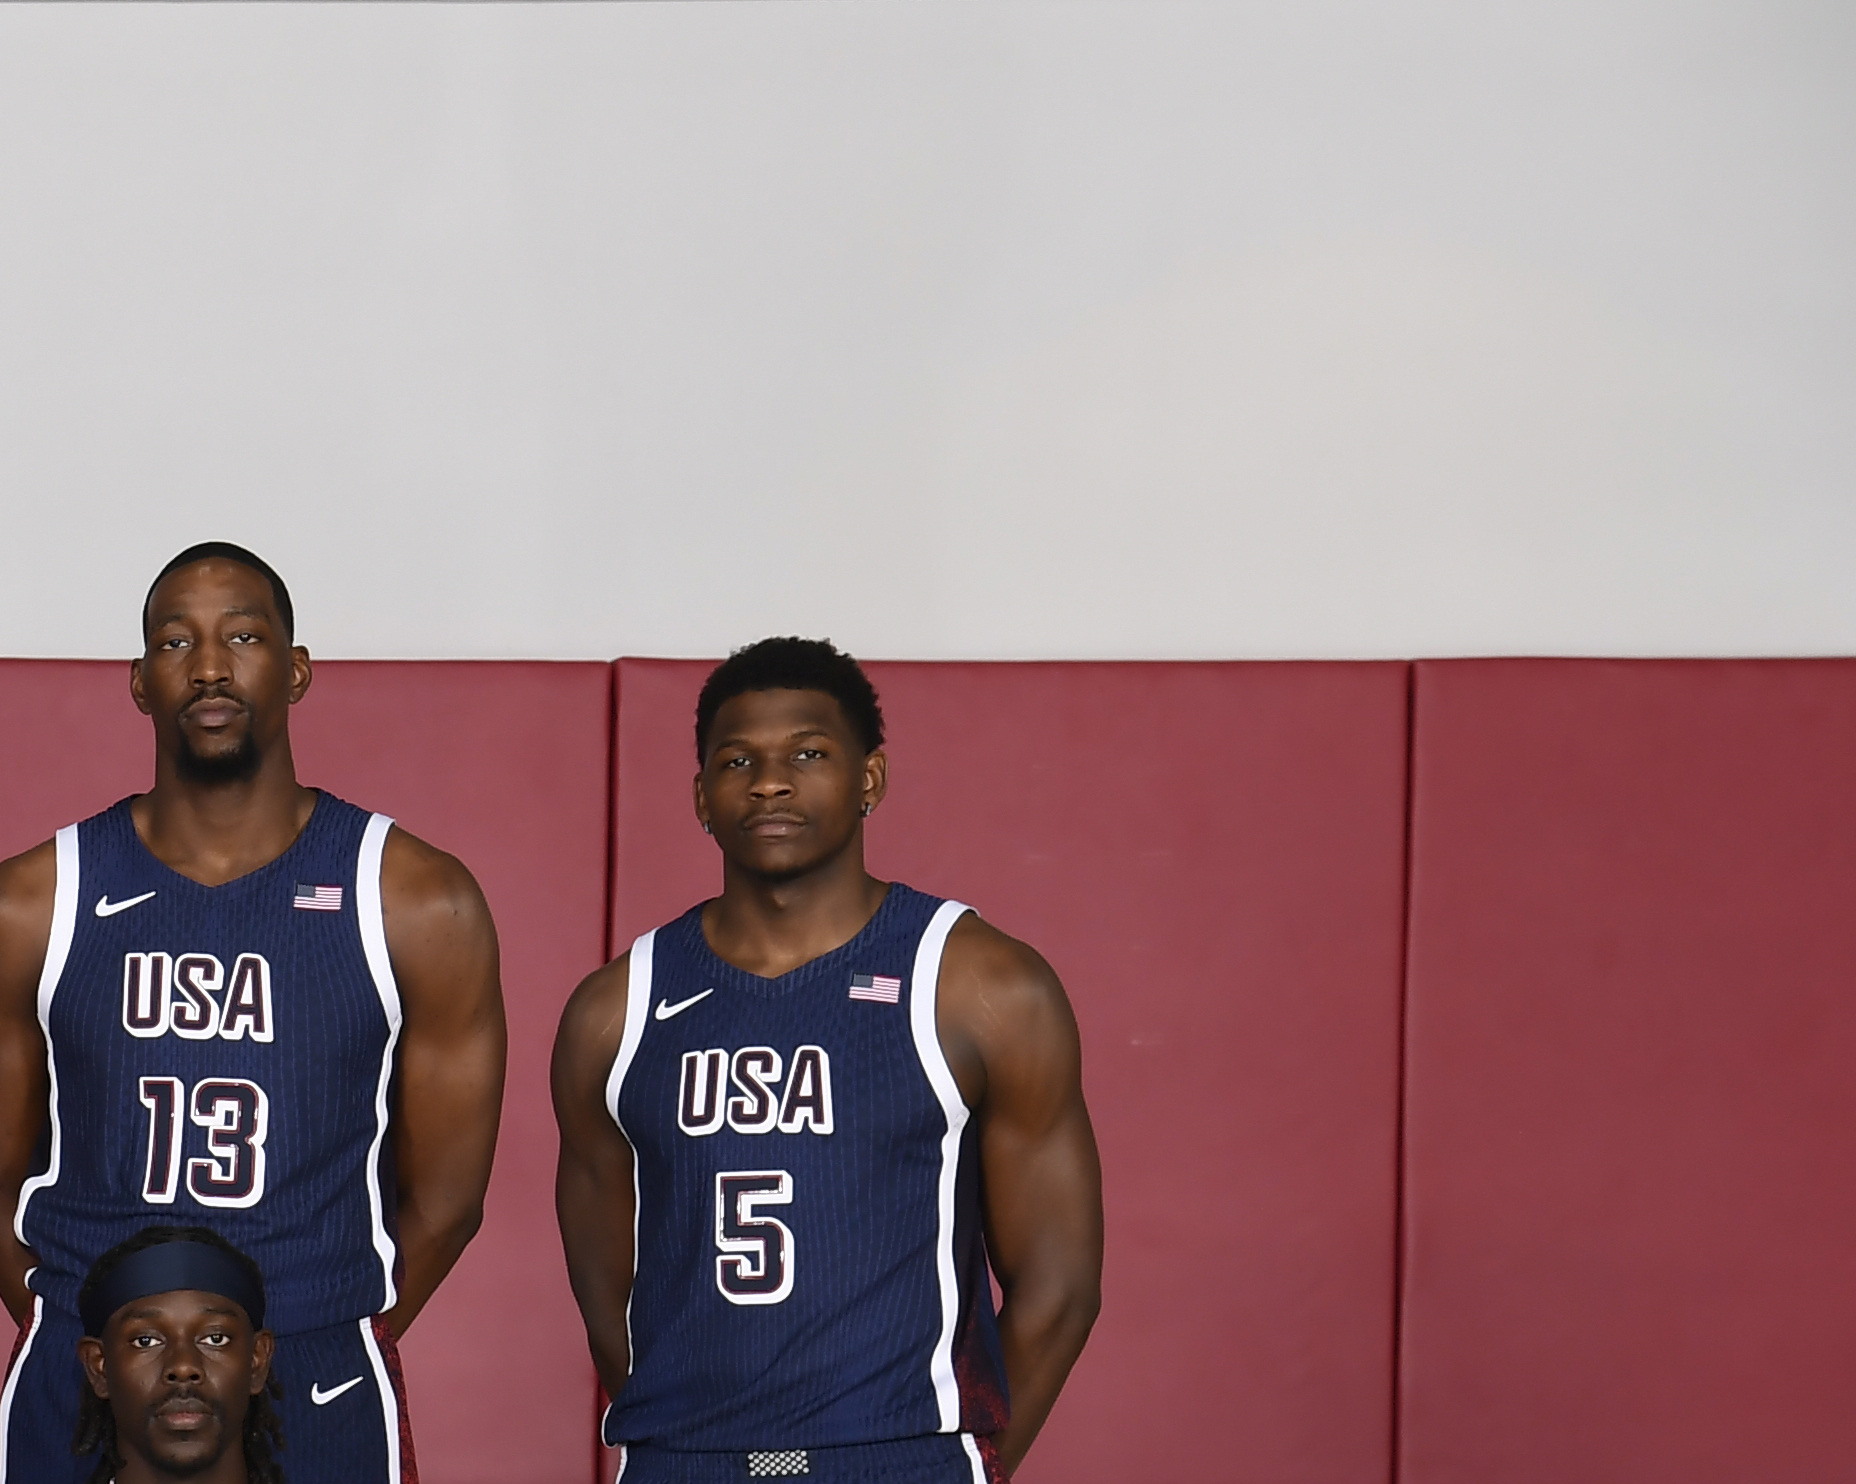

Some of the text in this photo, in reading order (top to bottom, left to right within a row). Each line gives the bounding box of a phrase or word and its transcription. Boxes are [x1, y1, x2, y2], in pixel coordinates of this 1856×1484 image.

[122, 951, 274, 1043] USA
[138, 1076, 269, 1209] 13
[677, 1044, 834, 1137] USA
[715, 1169, 795, 1305] 5
